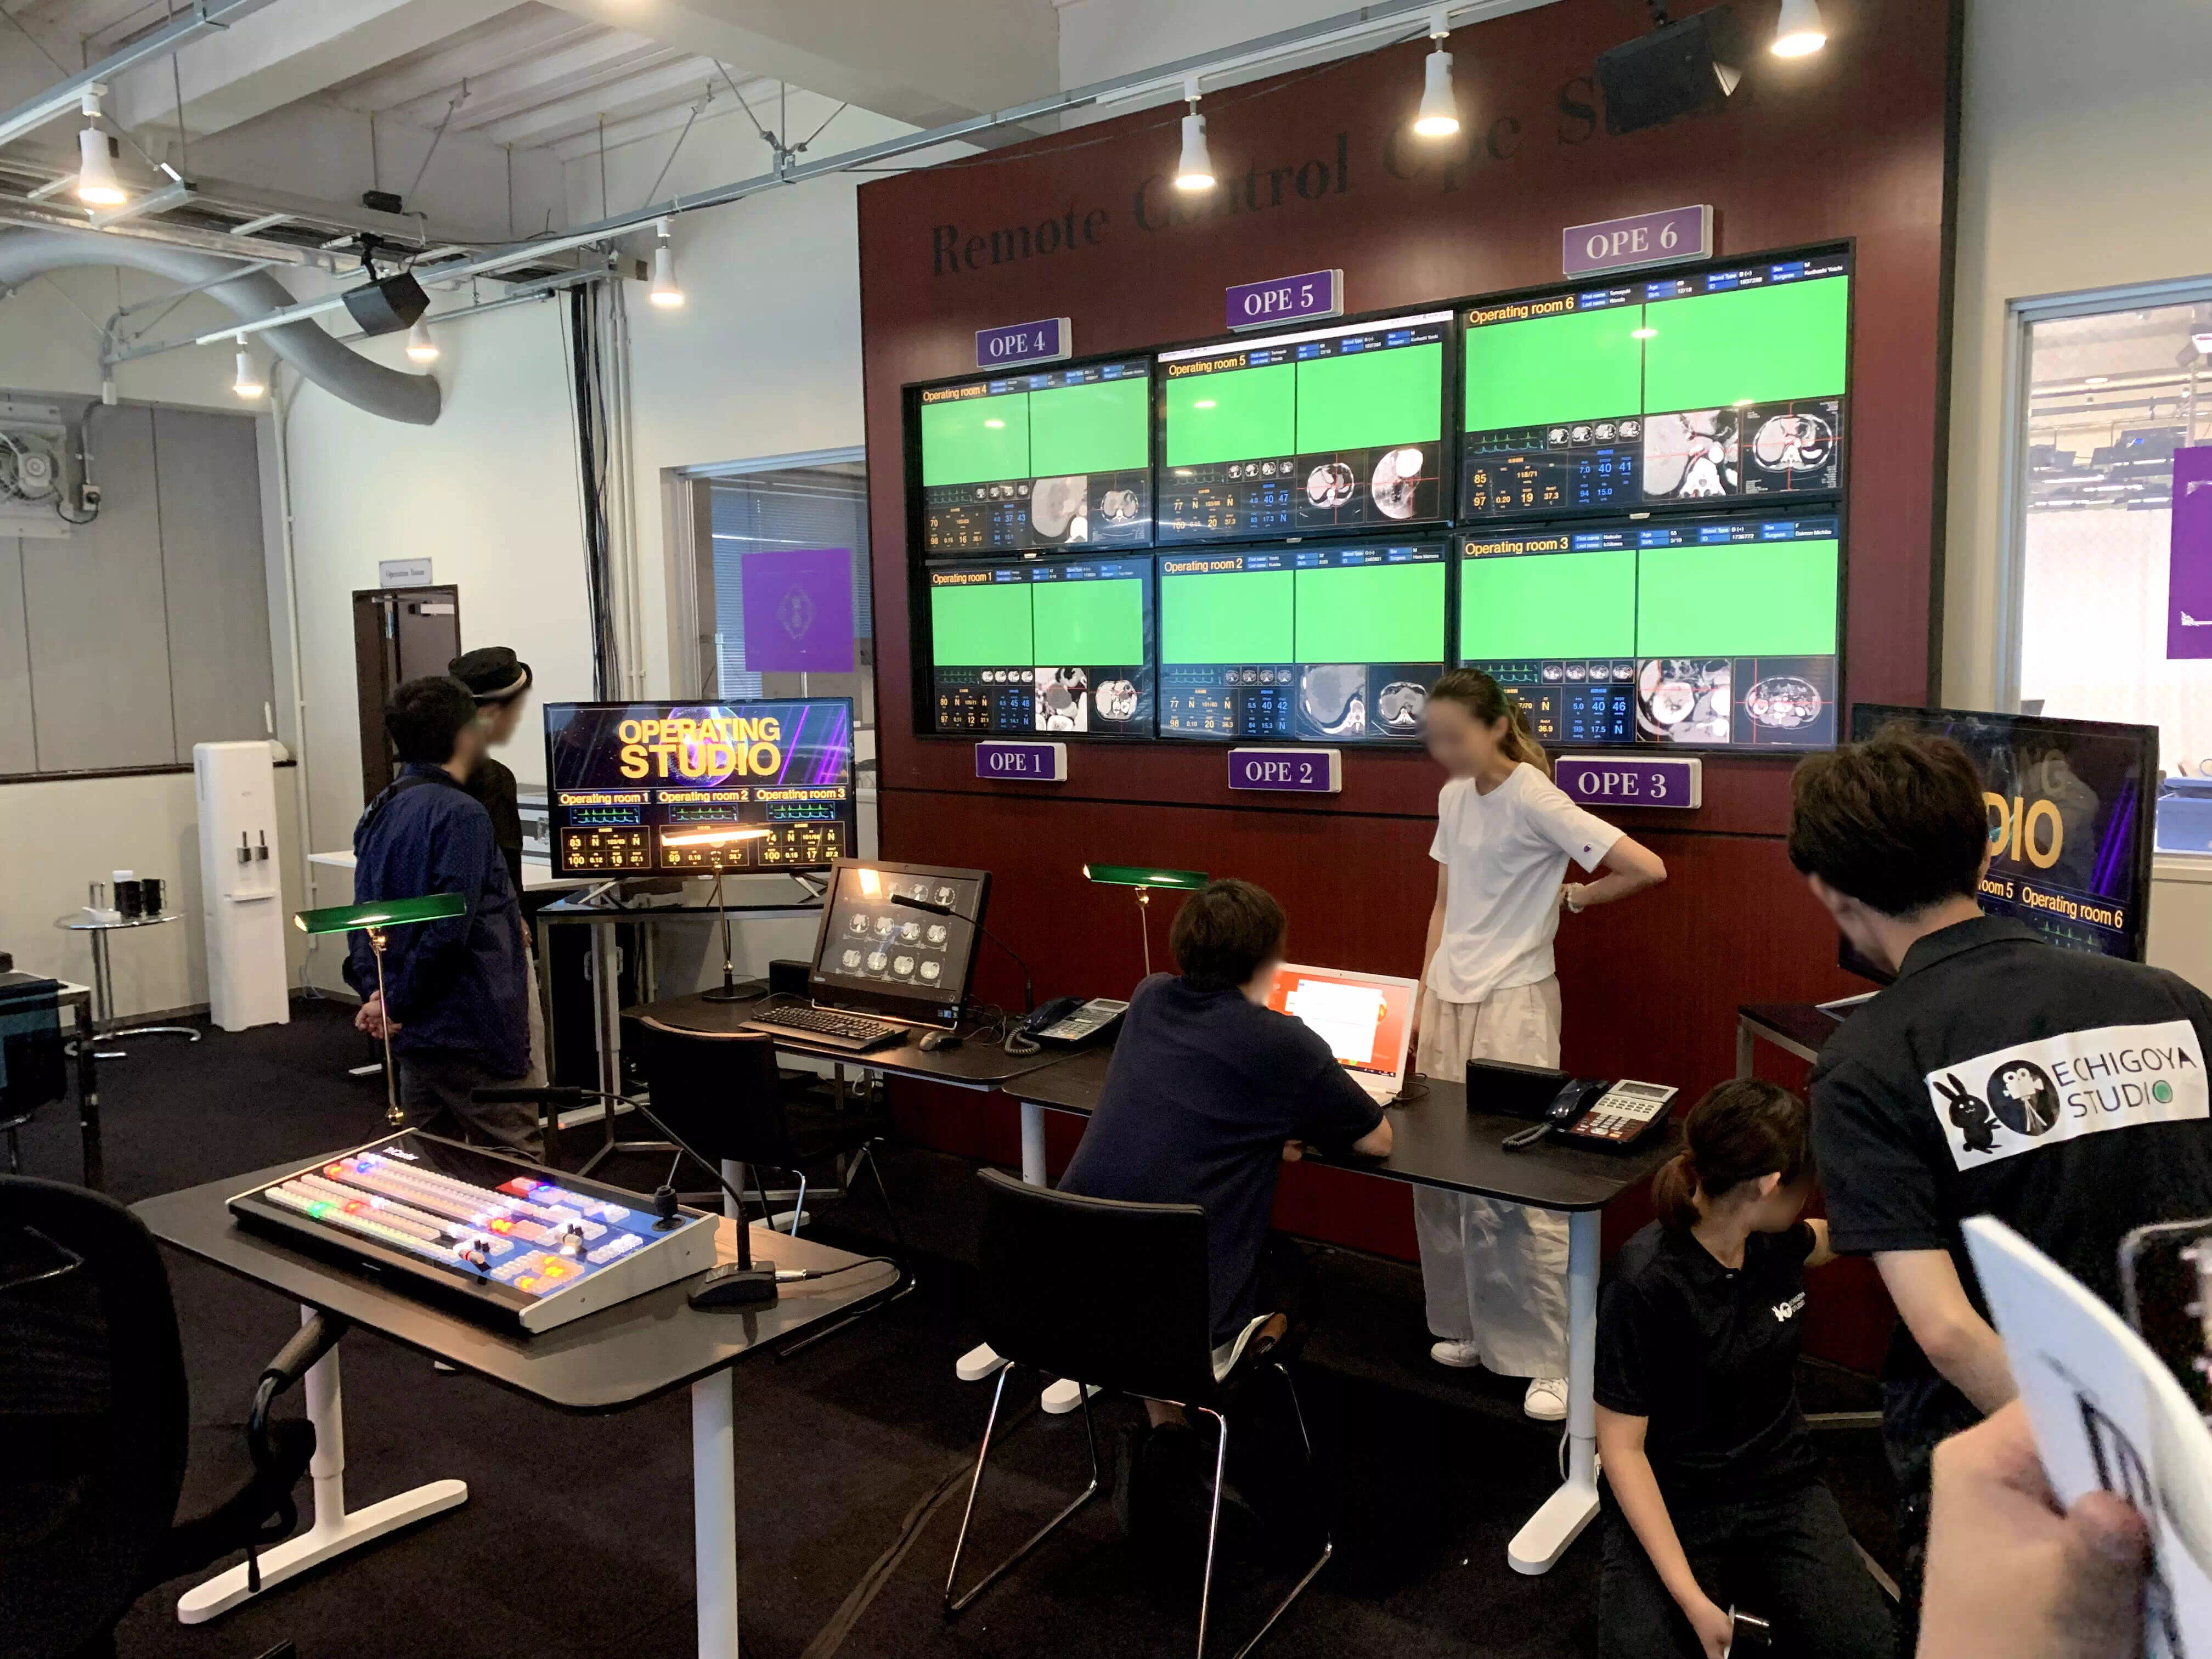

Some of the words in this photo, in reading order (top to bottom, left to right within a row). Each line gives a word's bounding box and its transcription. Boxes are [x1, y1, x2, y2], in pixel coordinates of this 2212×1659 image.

[931, 205, 1107, 277] Remote
[1586, 227, 1649, 259] OPE
[1660, 222, 1678, 249] 6
[1244, 287, 1293, 316] OPE
[1300, 283, 1314, 308] 5
[1469, 304, 1529, 325] Operating
[1531, 300, 1564, 315] room
[1565, 296, 1575, 310] 6
[989, 333, 1029, 357] OPE
[1033, 330, 1046, 352] 4
[1169, 361, 1212, 376] Operating
[1214, 359, 1238, 369] room
[1239, 354, 1246, 366] 5
[923, 388, 960, 402] Operating
[960, 386, 980, 397] room
[981, 383, 987, 394] 4
[1598, 462, 1612, 473] 40
[1619, 461, 1632, 471] 41
[1474, 473, 1487, 483] 85
[1263, 494, 1274, 504] 40
[1278, 493, 1289, 503] 47
[1597, 488, 1613, 496] 15.0
[1173, 501, 1183, 511] 77
[1192, 501, 1199, 510] N
[1227, 498, 1234, 507] N
[1473, 496, 1487, 506] 97
[1496, 495, 1511, 504] 0.20
[1521, 493, 1534, 503] 19
[930, 519, 939, 527] 70
[1005, 514, 1014, 523] 37
[1207, 518, 1217, 528] 20
[1280, 514, 1286, 522] N
[1465, 540, 1523, 556] Operating
[1526, 538, 1558, 551] room
[1560, 537, 1569, 549] 3
[1164, 560, 1209, 573] Operating
[1210, 560, 1235, 570] room
[1236, 557, 1243, 569] 2
[932, 573, 967, 585] Operating
[968, 573, 987, 582] room
[988, 572, 992, 581] 1
[954, 698, 960, 706] N
[1170, 700, 1179, 708] 77
[1188, 700, 1195, 708] N
[1224, 700, 1231, 709] N
[1262, 701, 1272, 710] 40
[1277, 701, 1288, 710] 42
[1541, 701, 1550, 711] N
[1592, 702, 1605, 712] 40
[1612, 702, 1626, 712] 46
[967, 715, 975, 724] 12
[1170, 719, 1180, 728] 98
[1204, 720, 1215, 728] 20
[1279, 721, 1286, 730] N
[618, 716, 781, 744] OPERATING
[1615, 725, 1623, 735] N
[619, 740, 782, 779] STUDIO
[989, 752, 1026, 771] OPE
[1033, 753, 1042, 773] 1
[1245, 761, 1292, 782] OPE
[1299, 762, 1313, 784] 2
[1578, 771, 1640, 795] OPE
[1650, 773, 1667, 798] 3
[560, 793, 612, 805] Operating
[613, 793, 641, 803] room
[642, 792, 648, 803] 1
[659, 791, 711, 803] Operating
[712, 792, 740, 802] room
[741, 789, 749, 801] 2
[756, 788, 809, 801] Operating
[809, 789, 837, 799] room
[838, 787, 846, 798] 3
[591, 838, 600, 847] N
[632, 837, 640, 846] N
[787, 833, 795, 842] N
[827, 832, 835, 841] N
[568, 856, 585, 865] 100
[764, 851, 780, 860] 100
[806, 850, 817, 859] 17
[2006, 881, 2014, 899] 5
[2022, 885, 2078, 920] Operating
[2079, 904, 2112, 926] room
[2114, 910, 2124, 929] 6
[2051, 1046, 2197, 1087] ECHIGOYA
[2067, 1079, 2174, 1118] STUDIO
